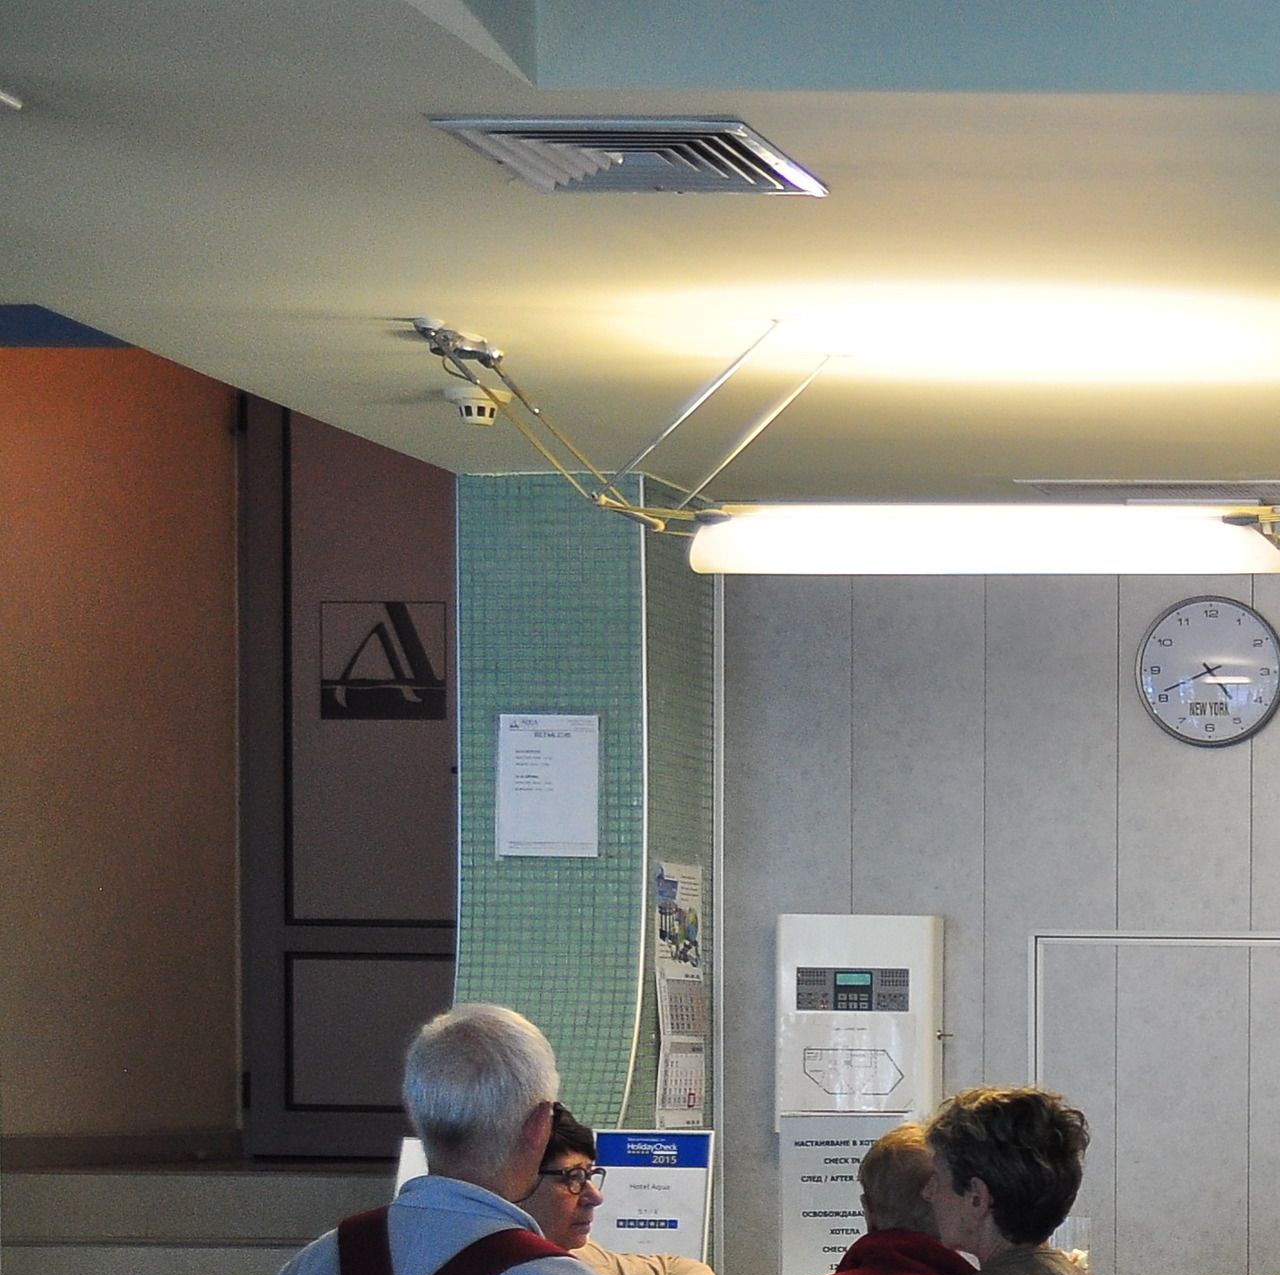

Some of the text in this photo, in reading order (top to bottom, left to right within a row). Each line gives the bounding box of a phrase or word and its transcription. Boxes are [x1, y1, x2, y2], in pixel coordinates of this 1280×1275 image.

[1204, 610, 1219, 618] 12
[1178, 618, 1190, 626] 11
[1237, 618, 1241, 626] 1
[1158, 638, 1173, 647] 10
[1253, 639, 1263, 647] 2
[1151, 666, 1160, 675] 9
[1260, 668, 1270, 676] 3
[1158, 694, 1168, 702] 8
[1189, 702, 1229, 716] NEW YORK
[1205, 724, 1215, 732] 6
[652, 1155, 677, 1164] 2015
[823, 1157, 850, 1165] CHECK
